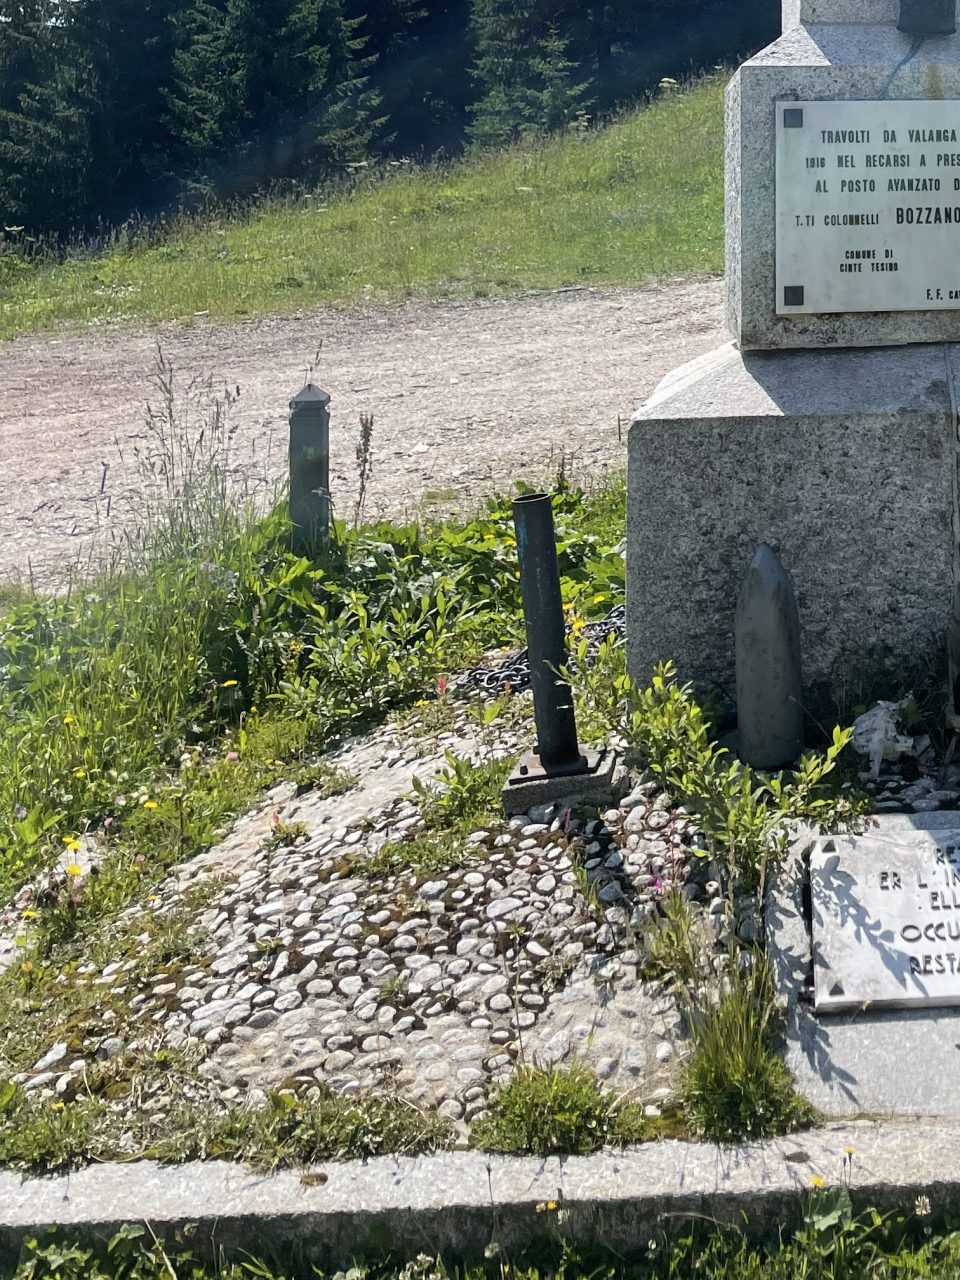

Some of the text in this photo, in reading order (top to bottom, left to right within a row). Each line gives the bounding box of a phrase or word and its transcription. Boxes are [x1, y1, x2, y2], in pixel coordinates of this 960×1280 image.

[821, 130, 870, 143] TRAVOLTI
[884, 130, 896, 142] DA
[908, 129, 957, 143] VALANGA
[806, 157, 826, 168] 1916
[838, 155, 855, 168] NEL
[865, 154, 910, 168] RECARSI
[920, 154, 926, 166] A
[815, 180, 828, 193] AL
[841, 179, 875, 192] POSTO
[888, 178, 941, 191] AVANZATO
[824, 214, 879, 226] COLONNELLI
[845, 249, 893, 259] COMUNE DI
[840, 263, 898, 272] CINTE TESINO
